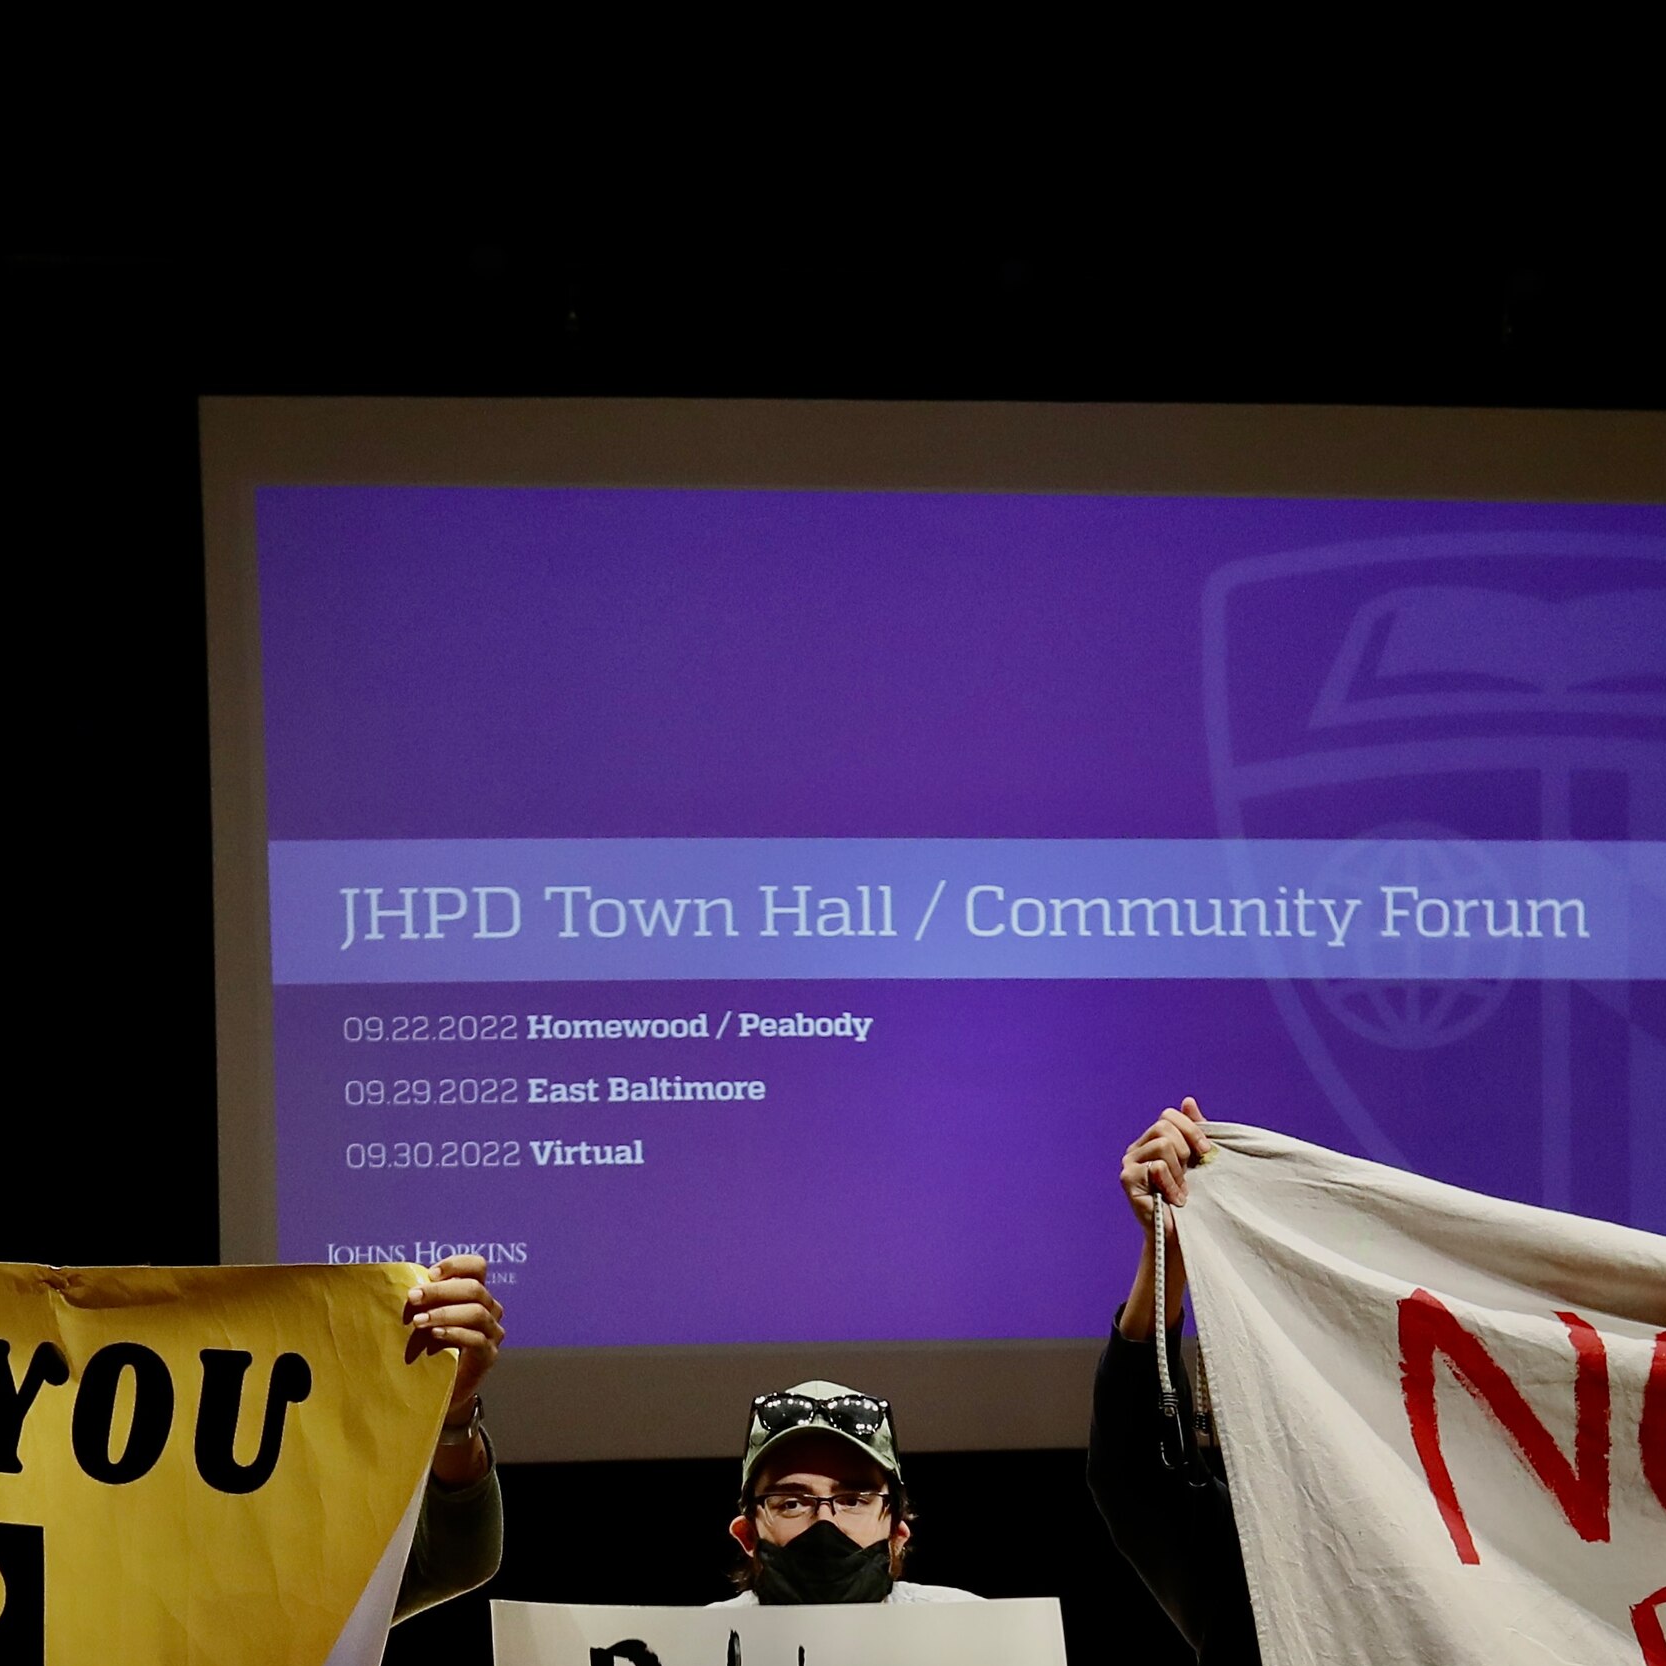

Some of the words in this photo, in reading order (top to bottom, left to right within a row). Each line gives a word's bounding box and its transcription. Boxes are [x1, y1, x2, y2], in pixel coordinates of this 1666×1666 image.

[338, 886, 522, 951] JHPD
[543, 885, 735, 939] Town
[758, 884, 898, 937] Hall
[965, 884, 1363, 948] Community
[1379, 885, 1591, 939] Forum
[342, 1014, 519, 1043] 09.22.2022
[526, 1012, 711, 1040] Homewood
[737, 1011, 875, 1043] Peabody
[344, 1077, 519, 1107] 09.29.2022
[526, 1077, 601, 1104] East
[607, 1075, 767, 1103] Baltimore
[345, 1140, 521, 1170] 09.30.2022
[528, 1139, 646, 1167] Virtual
[327, 1243, 406, 1264] JOHNS
